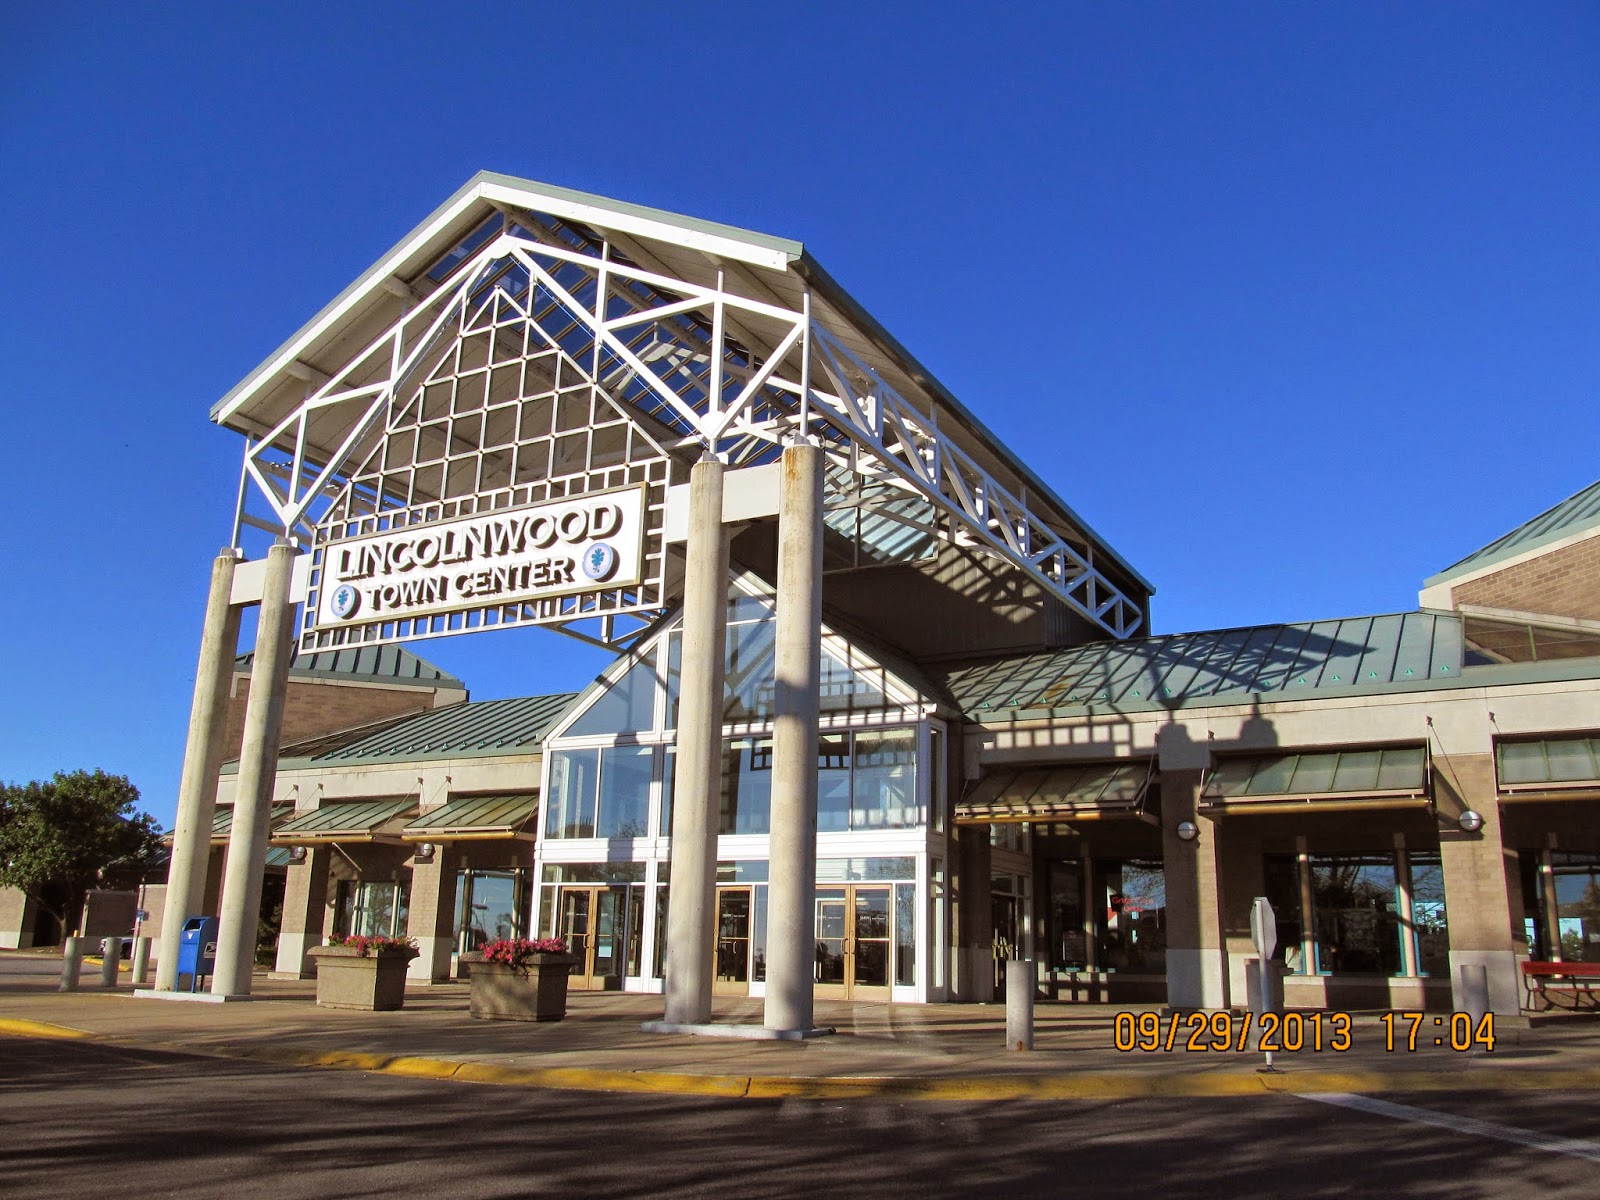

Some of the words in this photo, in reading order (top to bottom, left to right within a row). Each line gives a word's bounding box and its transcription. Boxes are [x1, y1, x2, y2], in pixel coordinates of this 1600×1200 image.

[336, 502, 622, 580] LINCOLNWOOD
[366, 575, 448, 610] TOWN
[452, 555, 575, 599] CENTER
